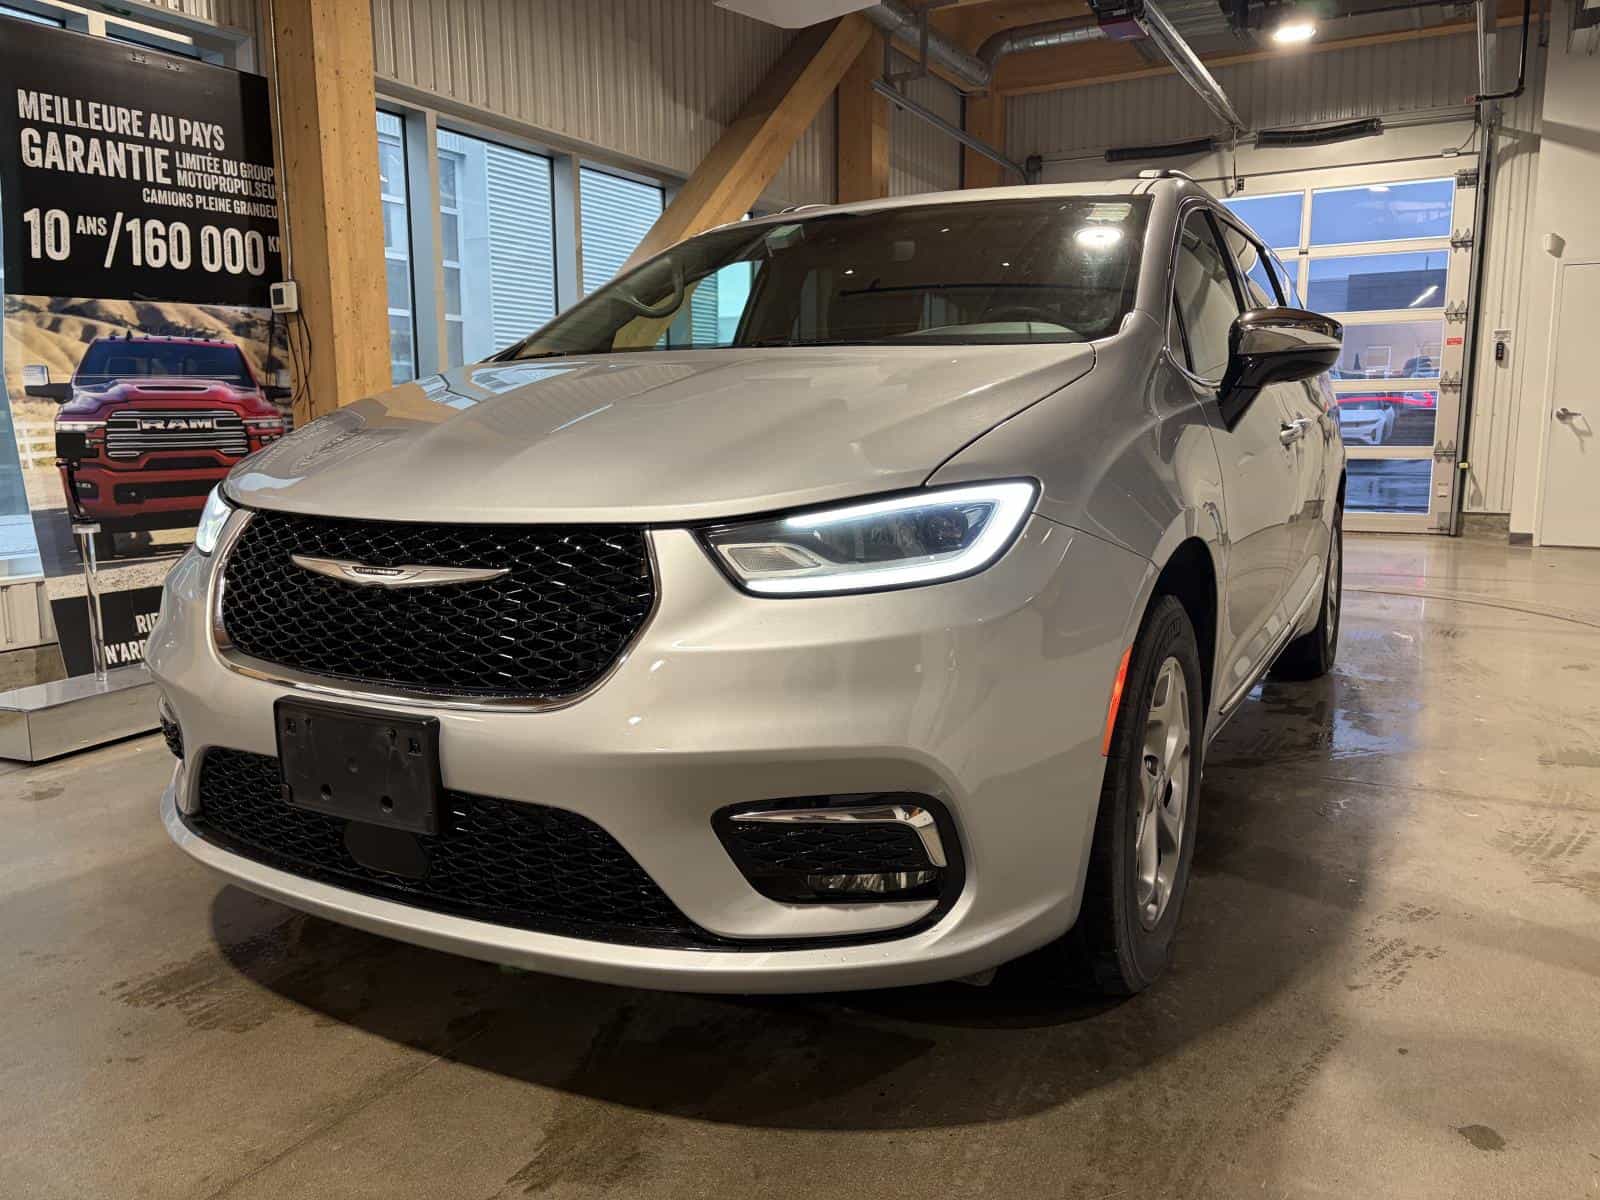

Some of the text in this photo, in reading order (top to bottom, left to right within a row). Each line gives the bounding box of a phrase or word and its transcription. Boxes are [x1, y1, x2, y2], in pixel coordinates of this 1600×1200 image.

[17, 88, 225, 151] MEILLEURE AU PAYS
[20, 127, 172, 185] GARANTIE
[175, 151, 220, 174] LIMITÉE
[222, 159, 238, 177] DU
[142, 187, 194, 209] CAMIONS
[195, 194, 232, 214] PLEINE
[23, 207, 70, 261] 10
[200, 224, 265, 277] 000
[142, 418, 212, 430] RAM
